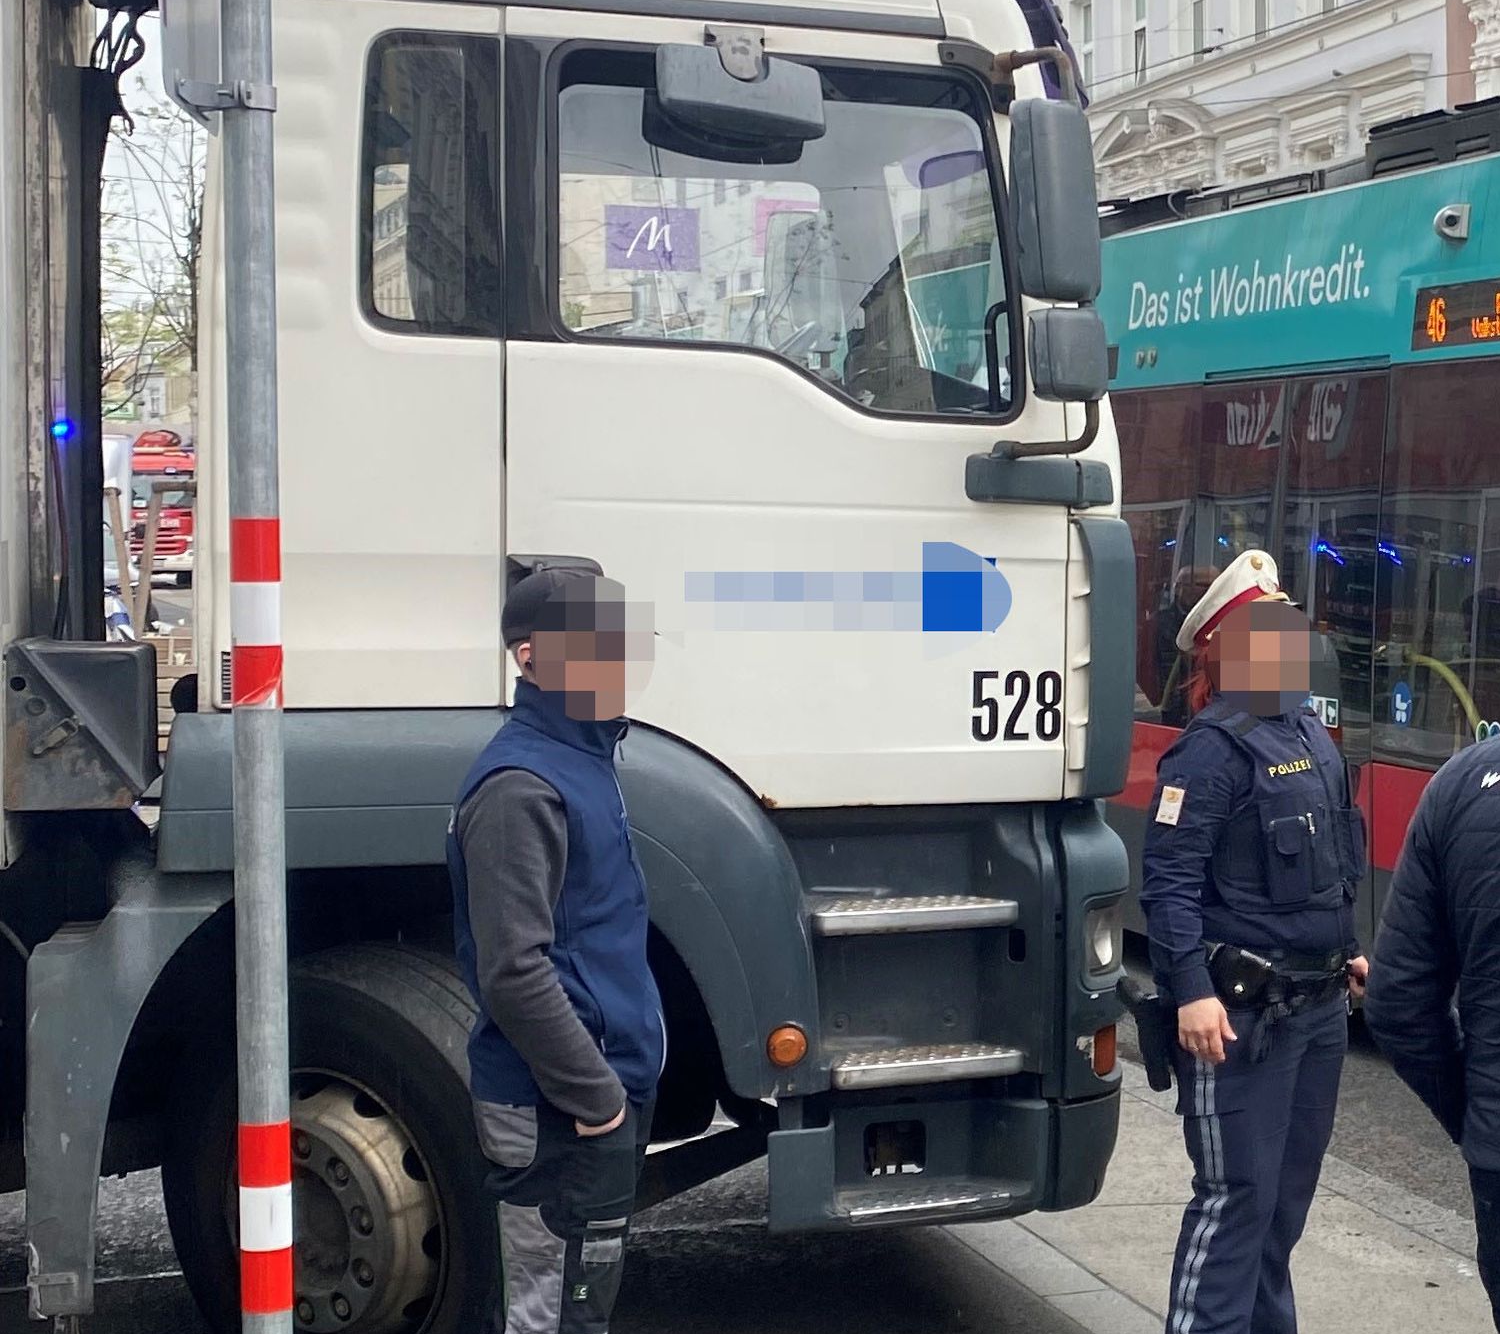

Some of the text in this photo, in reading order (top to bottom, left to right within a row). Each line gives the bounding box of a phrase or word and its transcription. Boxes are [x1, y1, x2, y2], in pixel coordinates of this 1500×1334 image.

[1128, 243, 1370, 330] Das ist Wohnkredit.
[1427, 297, 1447, 343] 46
[971, 670, 1062, 742] 528
[1268, 758, 1312, 778] POLIZEI
